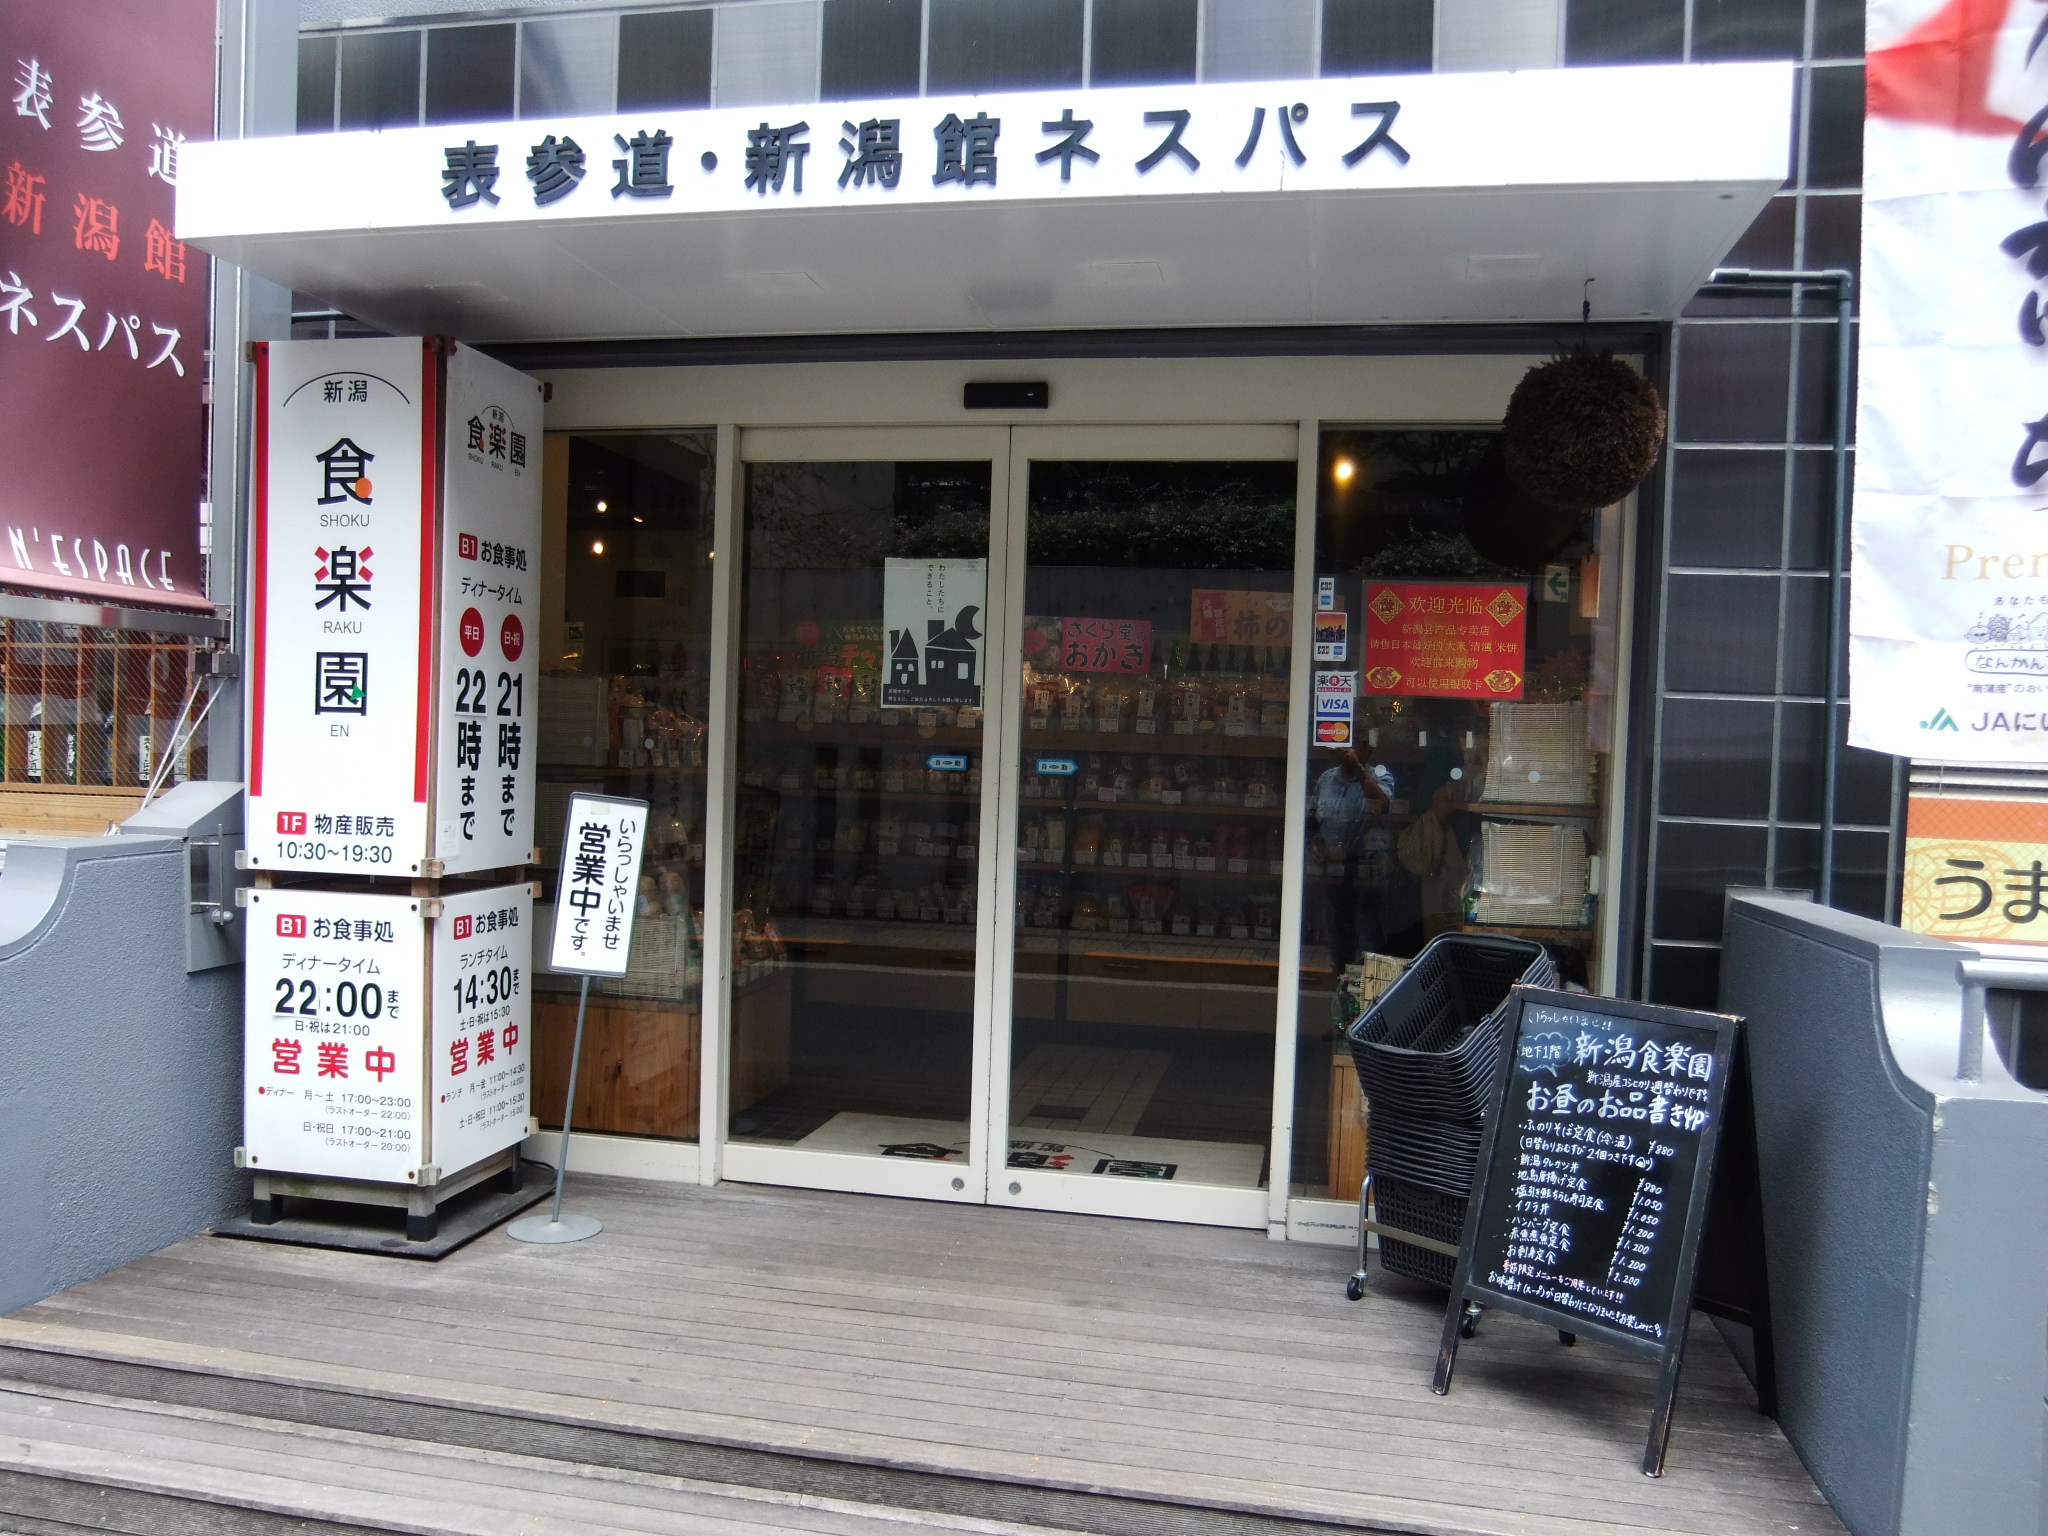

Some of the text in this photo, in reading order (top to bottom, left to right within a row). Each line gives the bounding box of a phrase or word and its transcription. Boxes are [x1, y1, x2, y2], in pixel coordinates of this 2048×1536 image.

[13, 59, 187, 187] 表参道
[441, 101, 1411, 208] 表参道・新潟館ネスパス
[2, 161, 187, 283] 新潟館
[0, 270, 185, 377] ネスパス
[324, 379, 368, 403] 新潟
[467, 415, 526, 468] 食楽園
[320, 514, 370, 527] SHOKU
[8, 525, 175, 591] N'ESPACE
[462, 537, 527, 572] B1 お食事処
[461, 577, 522, 605] ディナータイム
[938, 564, 946, 613] わたしたちに
[1408, 596, 1483, 616] 欢迎光临
[323, 621, 362, 634] RAKU
[464, 625, 480, 640] 平日
[1067, 622, 1147, 642] さくら堂の
[1065, 641, 1145, 670] おかき
[1409, 657, 1479, 670] 欢迎前来购物
[1406, 677, 1483, 691] 可以使用银联卡
[1321, 699, 1349, 710] VISA
[330, 725, 349, 737] EN
[1318, 728, 1349, 736] MasterCard
[281, 814, 395, 837] 1F 物産販売
[569, 821, 611, 956] 営業中です。
[602, 818, 636, 950] いらっしゃいませ
[281, 918, 394, 943] B1 お食事処
[457, 907, 519, 937] B1 お食事処
[282, 953, 380, 975] ディナータイム
[460, 945, 508, 969] ランチタイム
[275, 978, 399, 1020] 22:00 まで
[454, 966, 511, 1014] 14:30
[272, 1038, 396, 1083] 営業中
[451, 1021, 519, 1076] 営業中
[1520, 1045, 1562, 1060] 地下1階
[1573, 1031, 1713, 1081] 新潟食楽園
[266, 1087, 295, 1097] ディナー
[446, 1088, 463, 1102] ランチ
[1526, 1080, 1681, 1127] お昼のお品書き
[1648, 1141, 1674, 1157] ¥880
[1638, 1178, 1663, 1195] ¥880
[1514, 1200, 1550, 1215] イクラ丼
[1511, 1215, 1571, 1237] ハンバーグ定食
